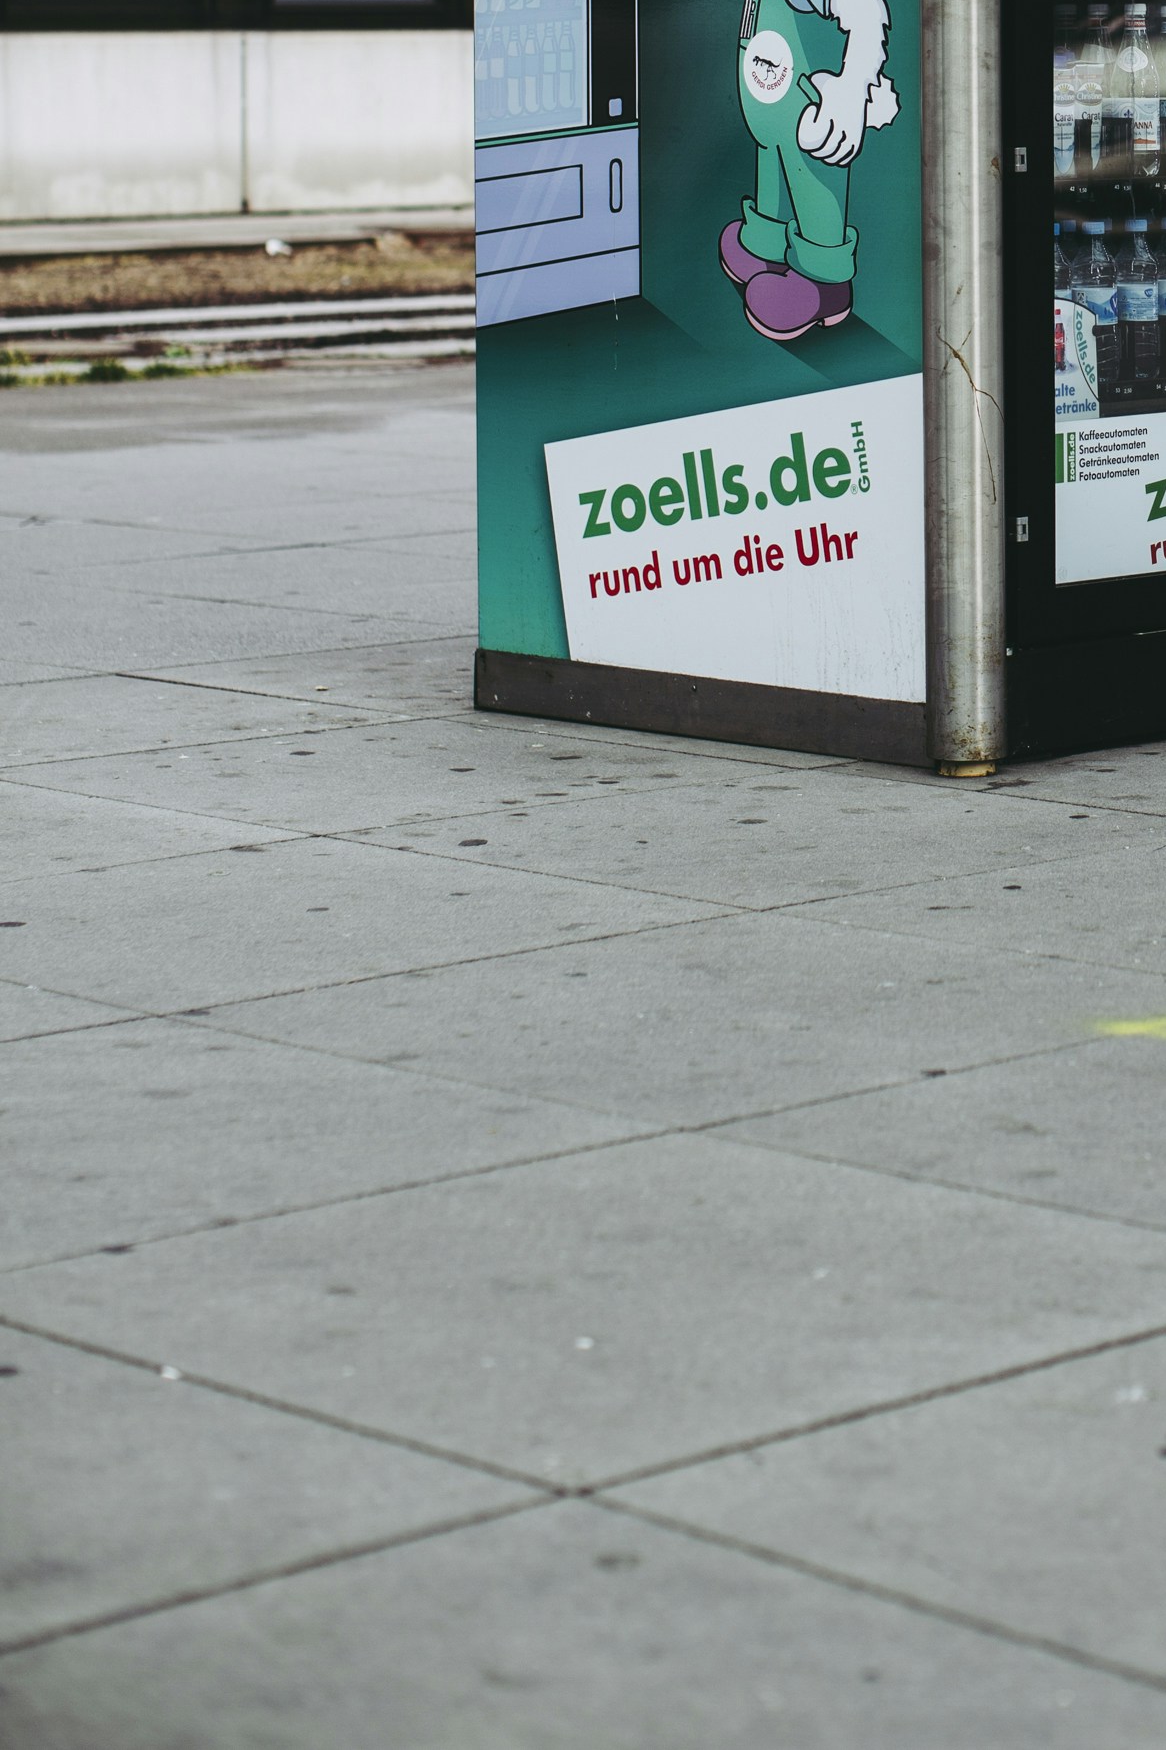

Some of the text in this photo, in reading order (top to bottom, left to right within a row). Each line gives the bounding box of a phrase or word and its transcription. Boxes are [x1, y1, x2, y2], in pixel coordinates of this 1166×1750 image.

[1076, 310, 1096, 385] zoells.de
[1054, 384, 1076, 398] alte
[1055, 399, 1097, 414] etränke
[1078, 426, 1148, 442] Kaffeeautomaten
[1078, 440, 1146, 455] Snackautomaten
[1068, 432, 1076, 482] zoells.de
[1078, 453, 1160, 468] Getränkeautomaten
[578, 420, 871, 539] zoells.de GmbH
[1078, 468, 1140, 482] Fotoautomaten
[588, 523, 859, 599] rund um die Uhr
